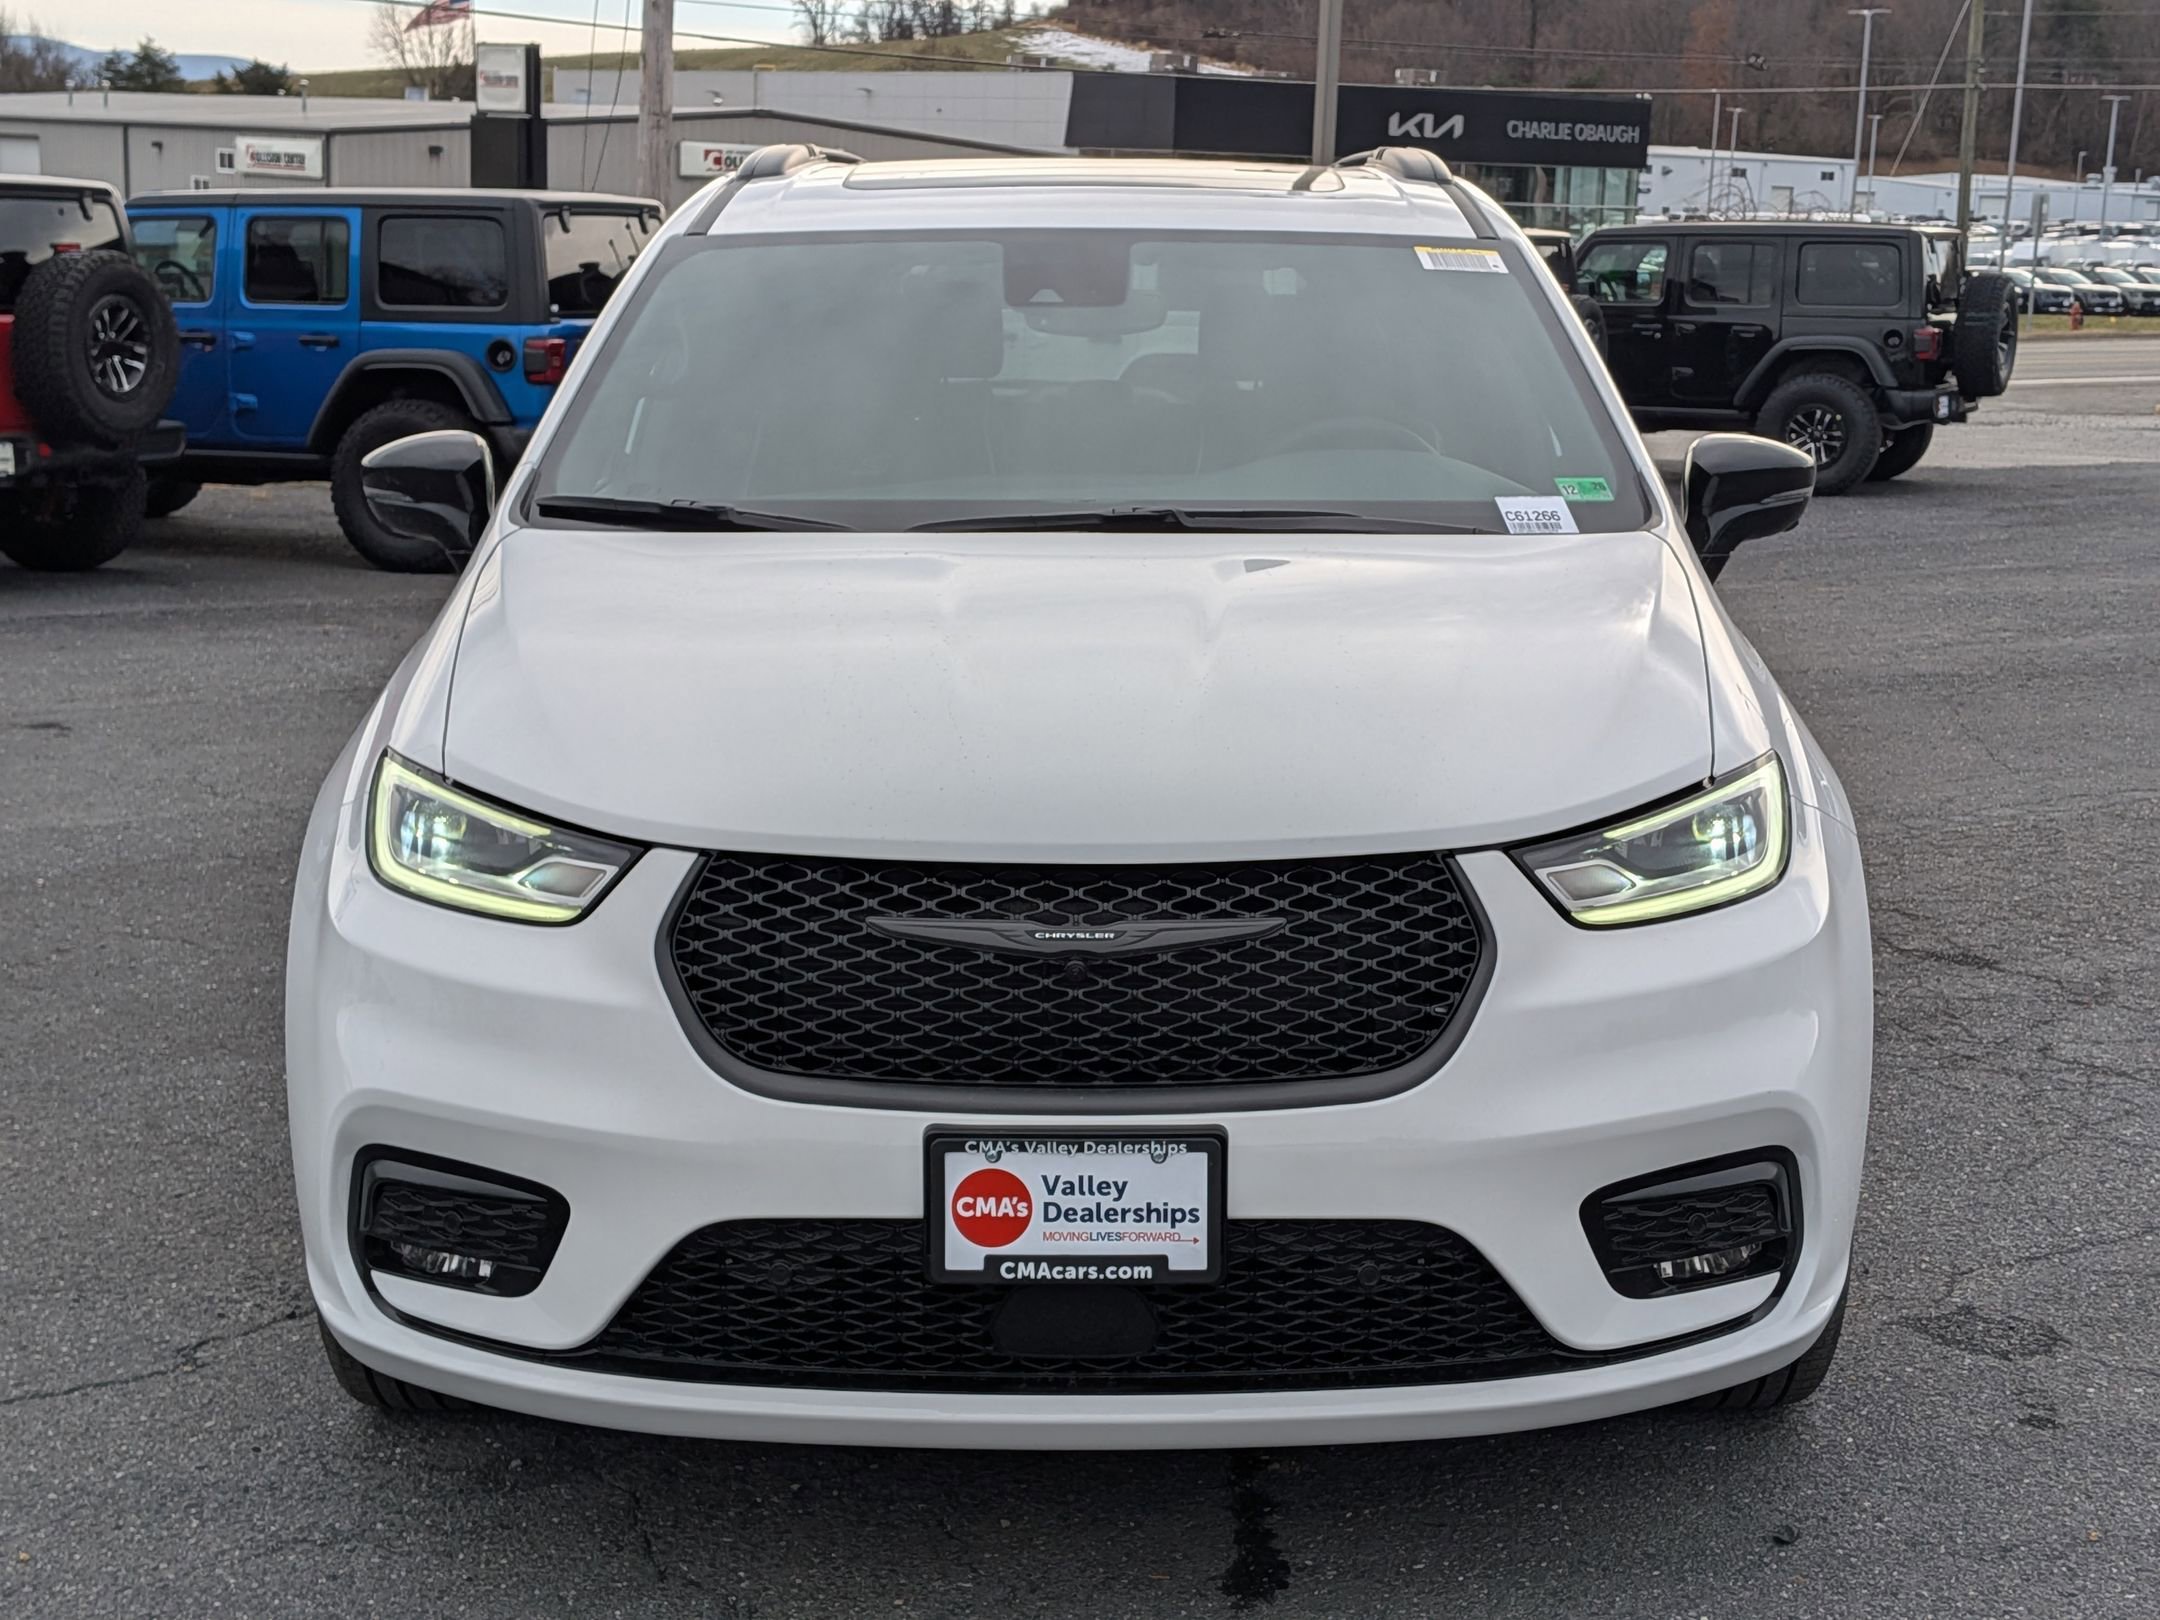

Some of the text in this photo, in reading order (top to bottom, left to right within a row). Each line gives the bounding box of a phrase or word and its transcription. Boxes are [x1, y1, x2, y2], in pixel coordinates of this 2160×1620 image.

[1387, 112, 1464, 139] KIA
[1507, 119, 1640, 144] CHARLIE OBAUGH
[1562, 484, 1578, 496] 12
[1505, 510, 1561, 522] C61266
[964, 1140, 1188, 1157] CMA's Valley Dealerships
[1041, 1174, 1129, 1202] Valley
[956, 1196, 1029, 1218] CMA's
[1042, 1202, 1200, 1229] Dealerships
[999, 1261, 1153, 1280] CMAcars.com
